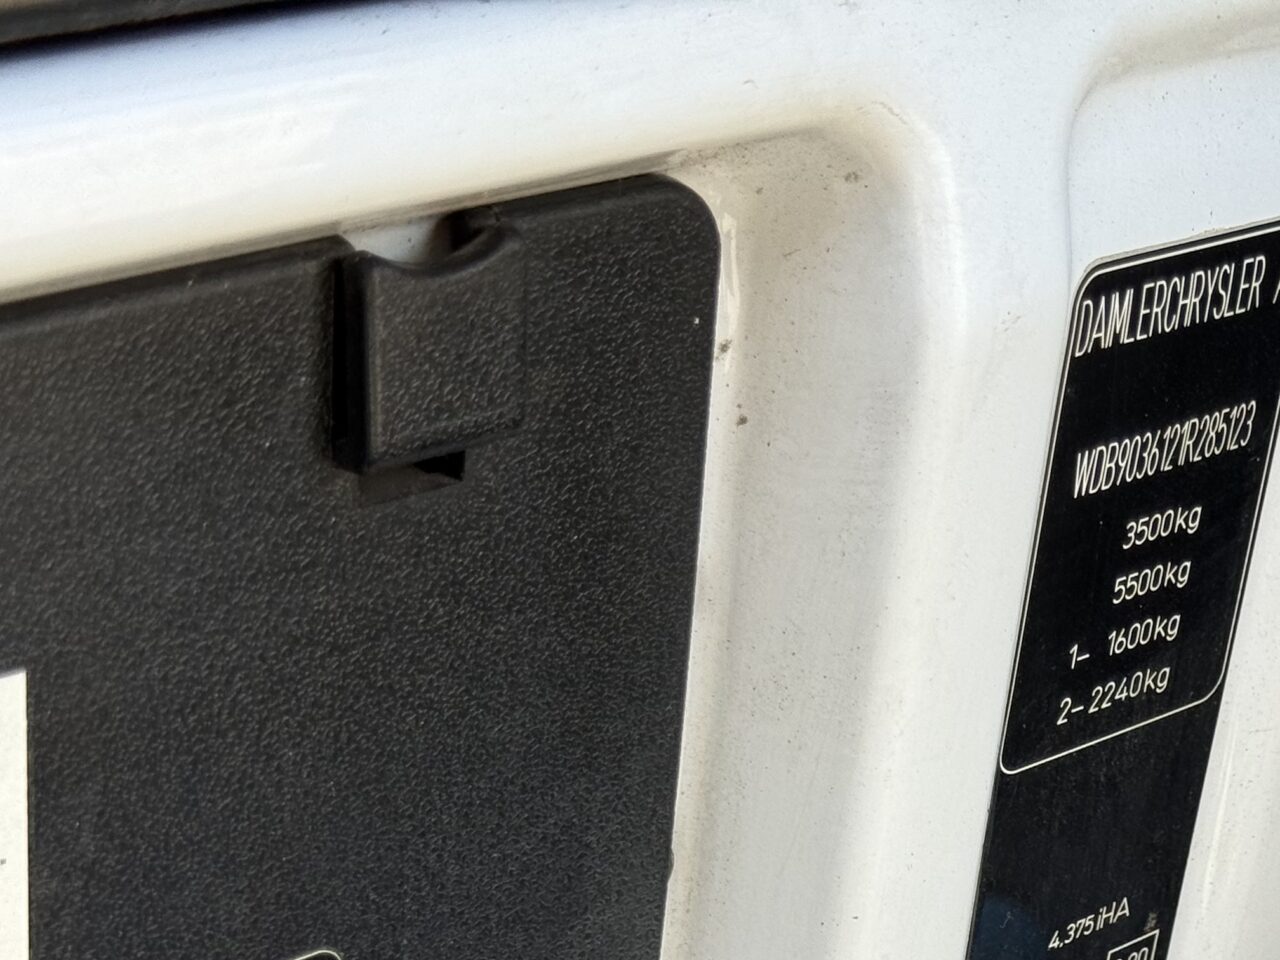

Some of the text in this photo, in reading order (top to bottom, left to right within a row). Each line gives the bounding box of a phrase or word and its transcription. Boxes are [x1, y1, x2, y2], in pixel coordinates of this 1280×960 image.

[1074, 255, 1266, 358] DAIMLERCHRYSLER
[1074, 400, 1256, 499] WDB9036121R285123
[1122, 506, 1202, 549] 3500kg
[1112, 561, 1191, 604] 5500kg
[1108, 614, 1181, 656] 1600kg
